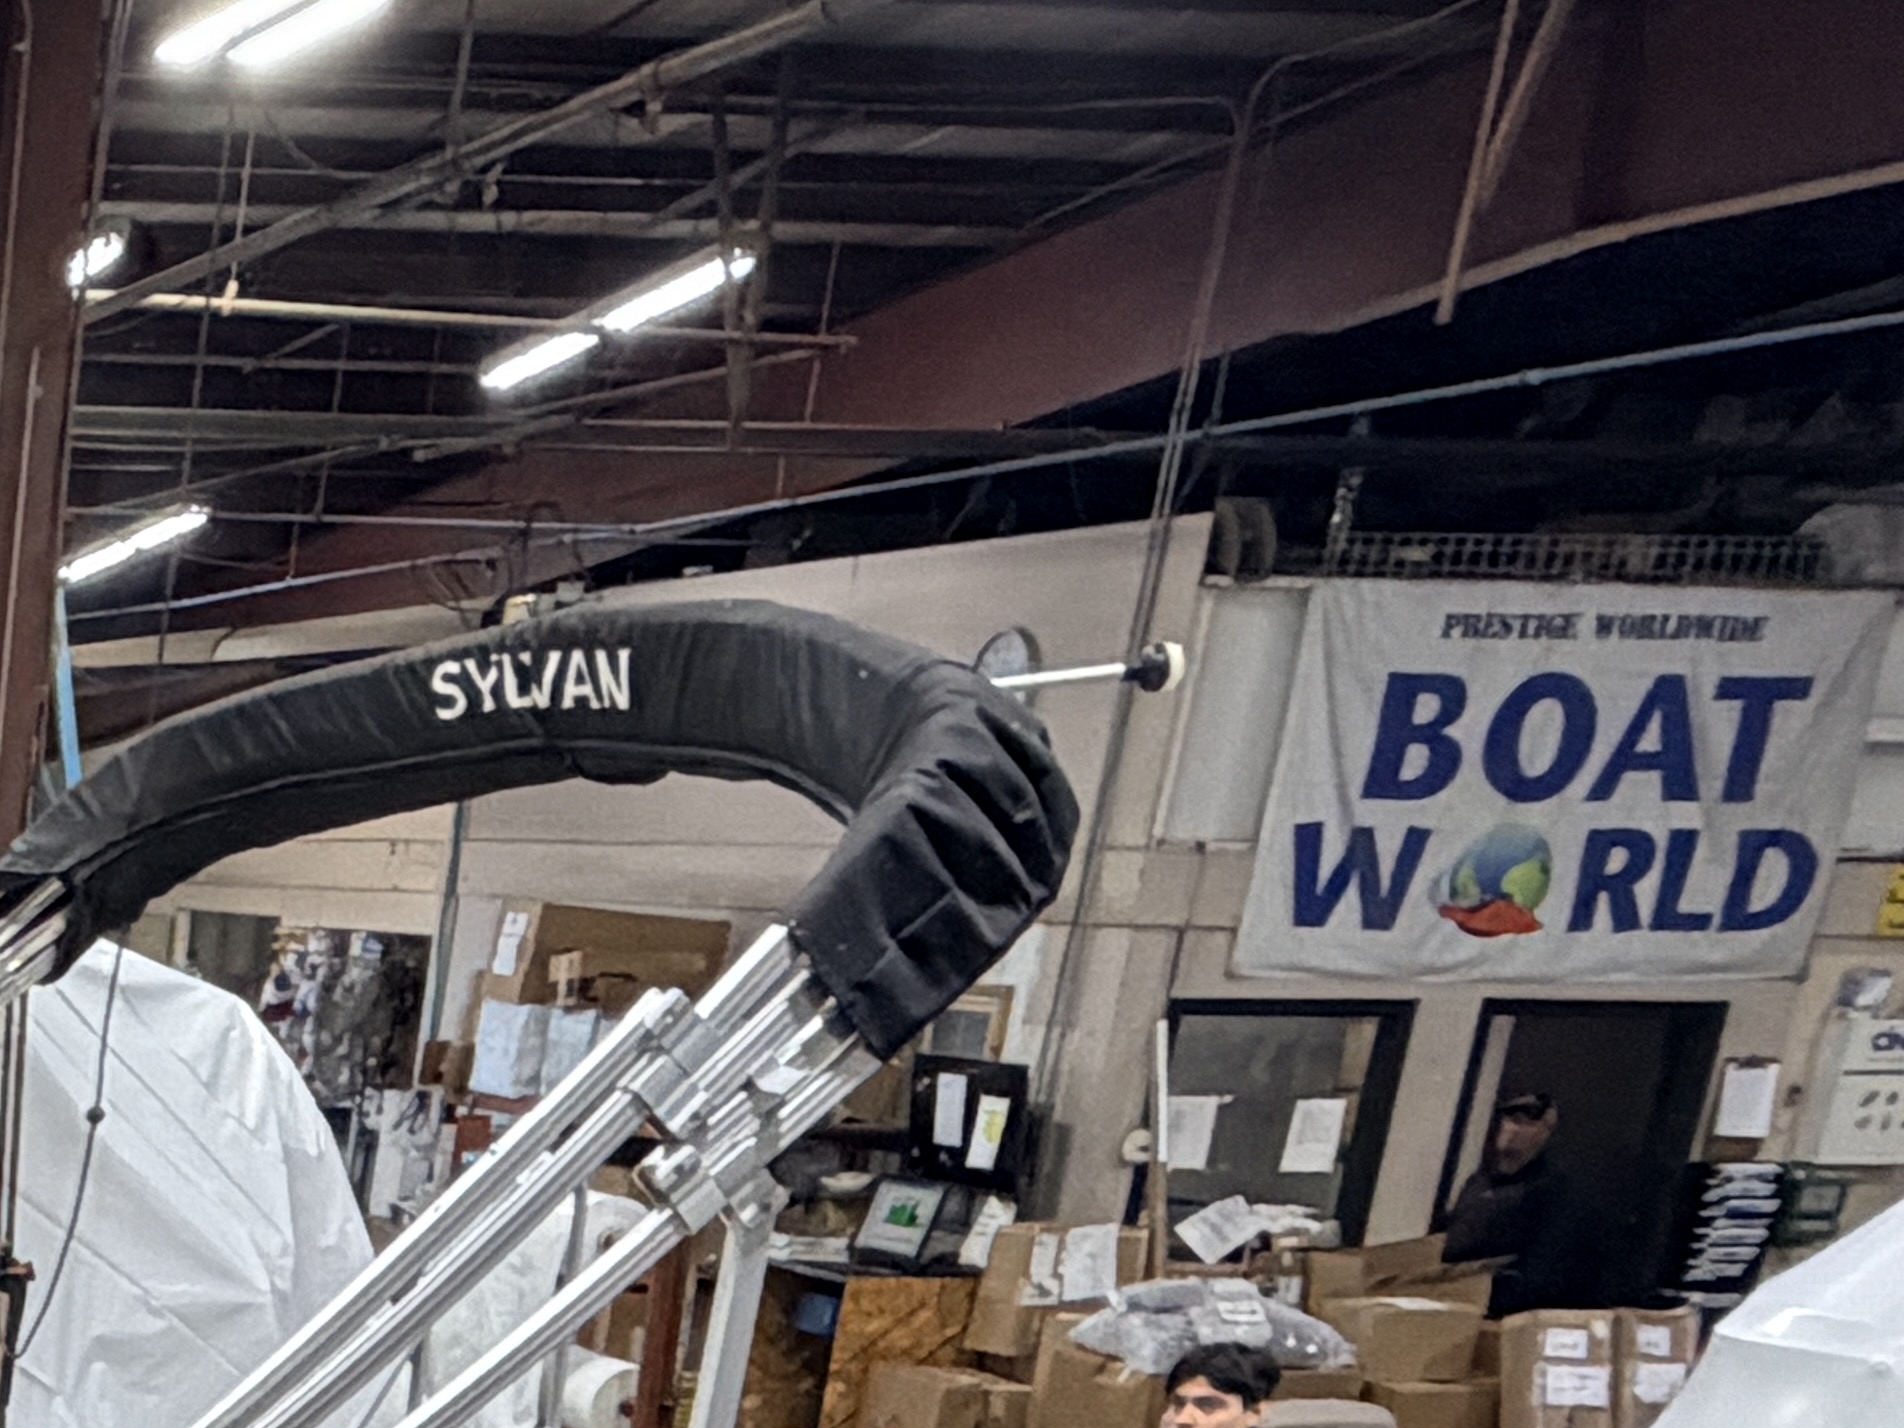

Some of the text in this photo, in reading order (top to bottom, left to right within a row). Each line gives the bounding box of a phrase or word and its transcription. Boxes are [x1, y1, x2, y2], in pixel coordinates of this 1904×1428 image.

[1440, 611, 1771, 643] PRESTIGE WORLDWIDE
[431, 647, 632, 721] SYLVAN
[1361, 671, 1814, 804] BOAT
